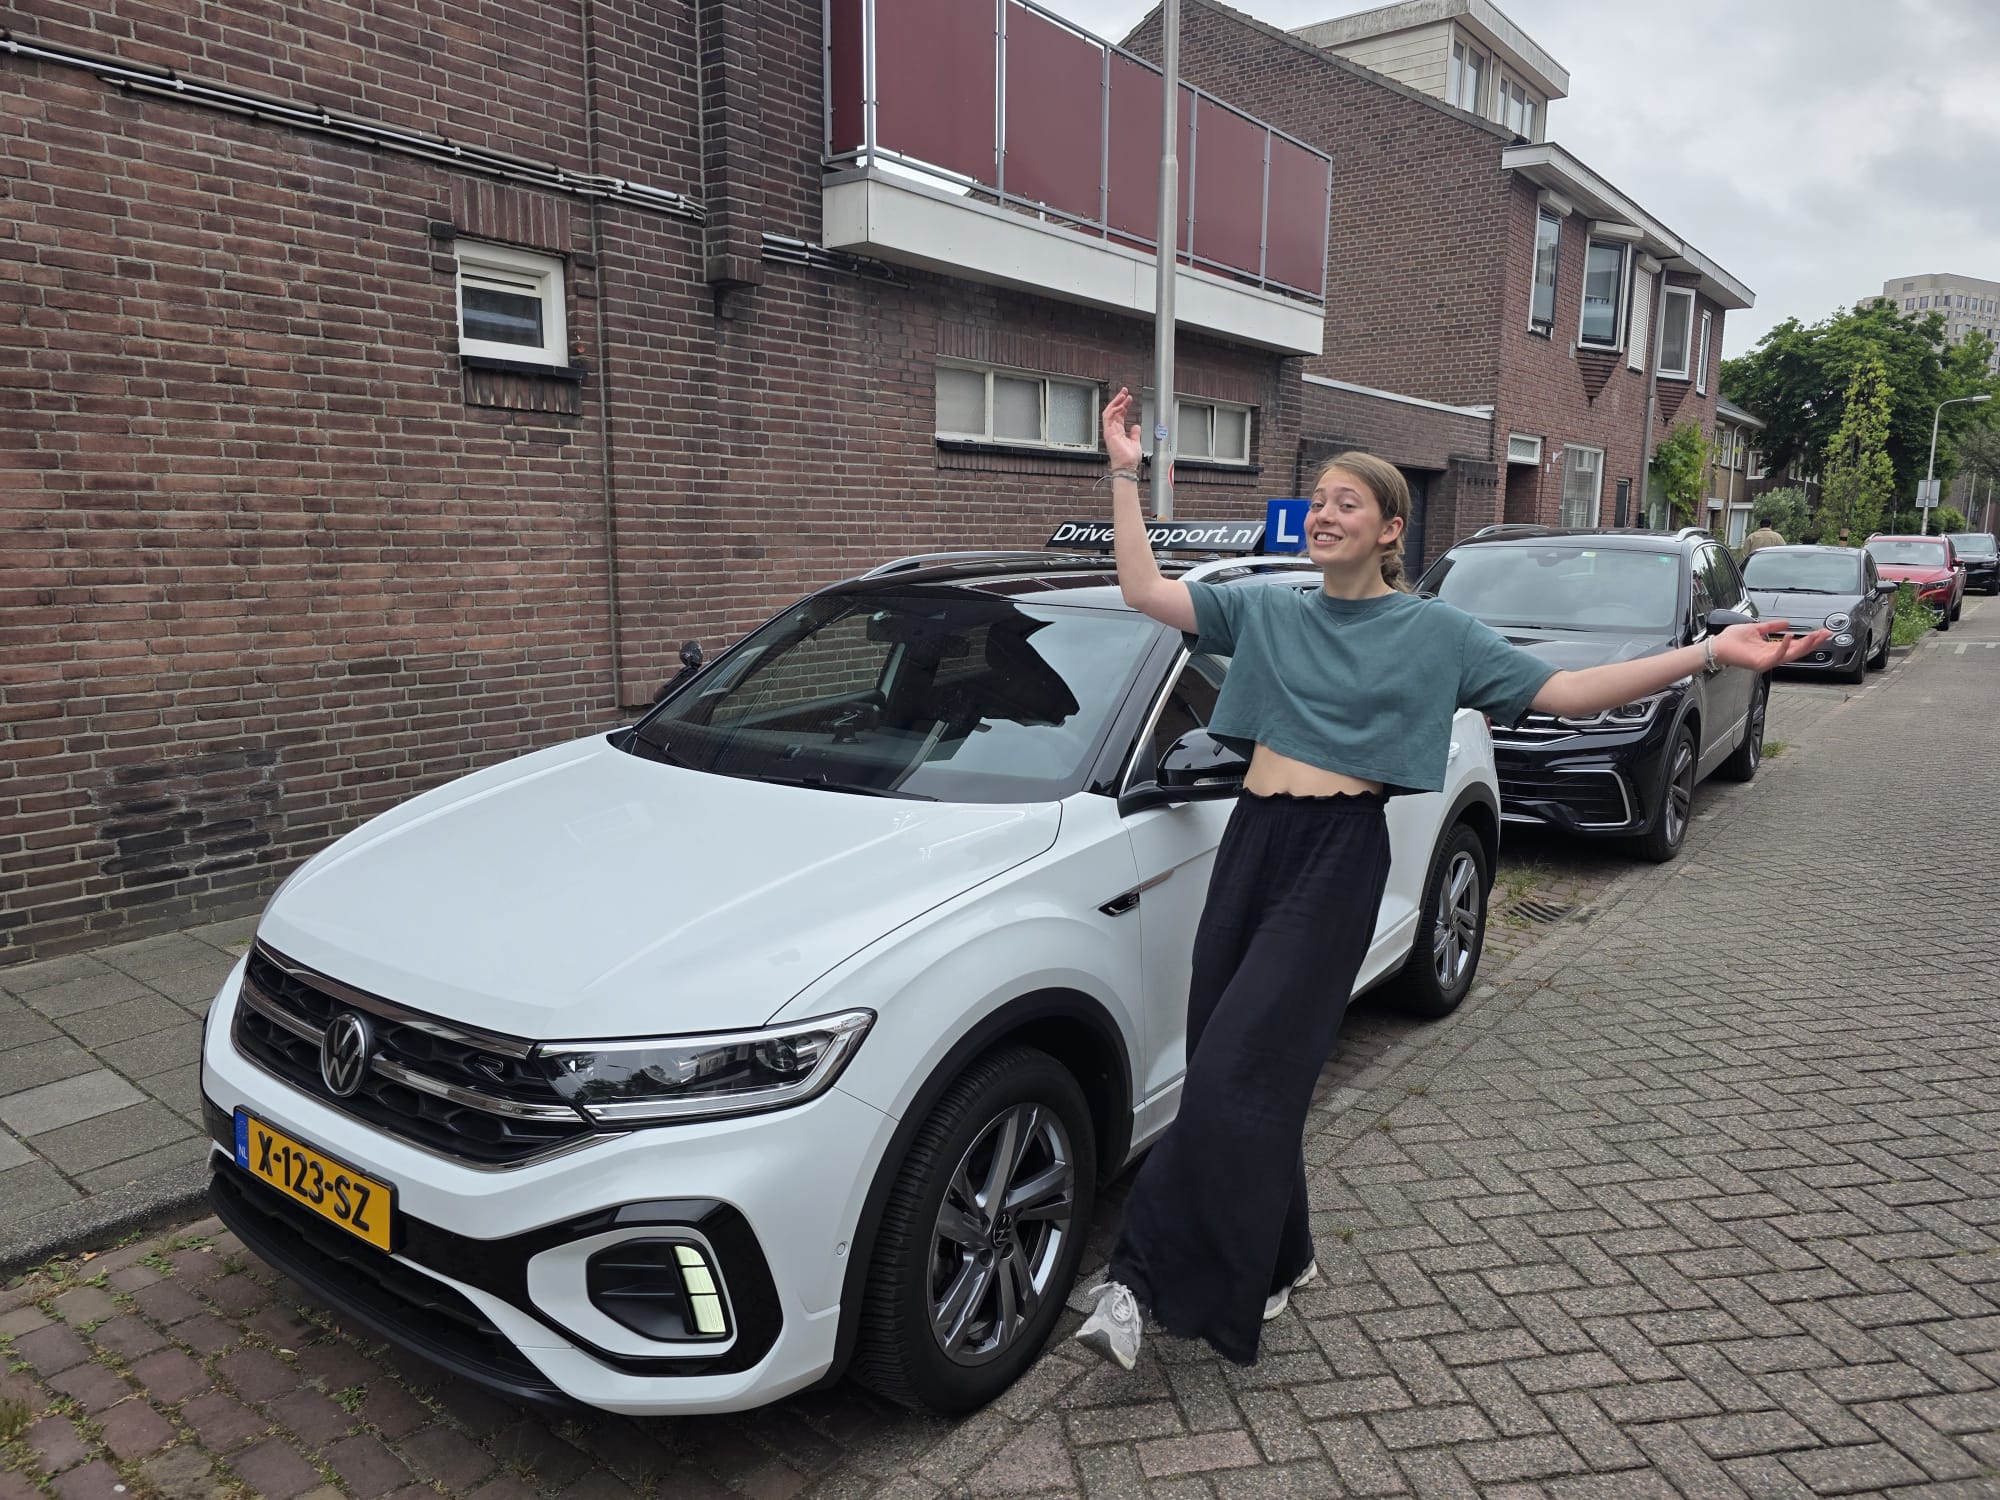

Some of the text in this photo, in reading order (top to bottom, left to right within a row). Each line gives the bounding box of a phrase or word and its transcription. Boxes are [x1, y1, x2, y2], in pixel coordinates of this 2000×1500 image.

[1052, 523, 1263, 547] Drivepport.nl
[1276, 509, 1299, 543] L
[238, 1143, 248, 1160] NL
[258, 1131, 370, 1232] X-123-SZ
